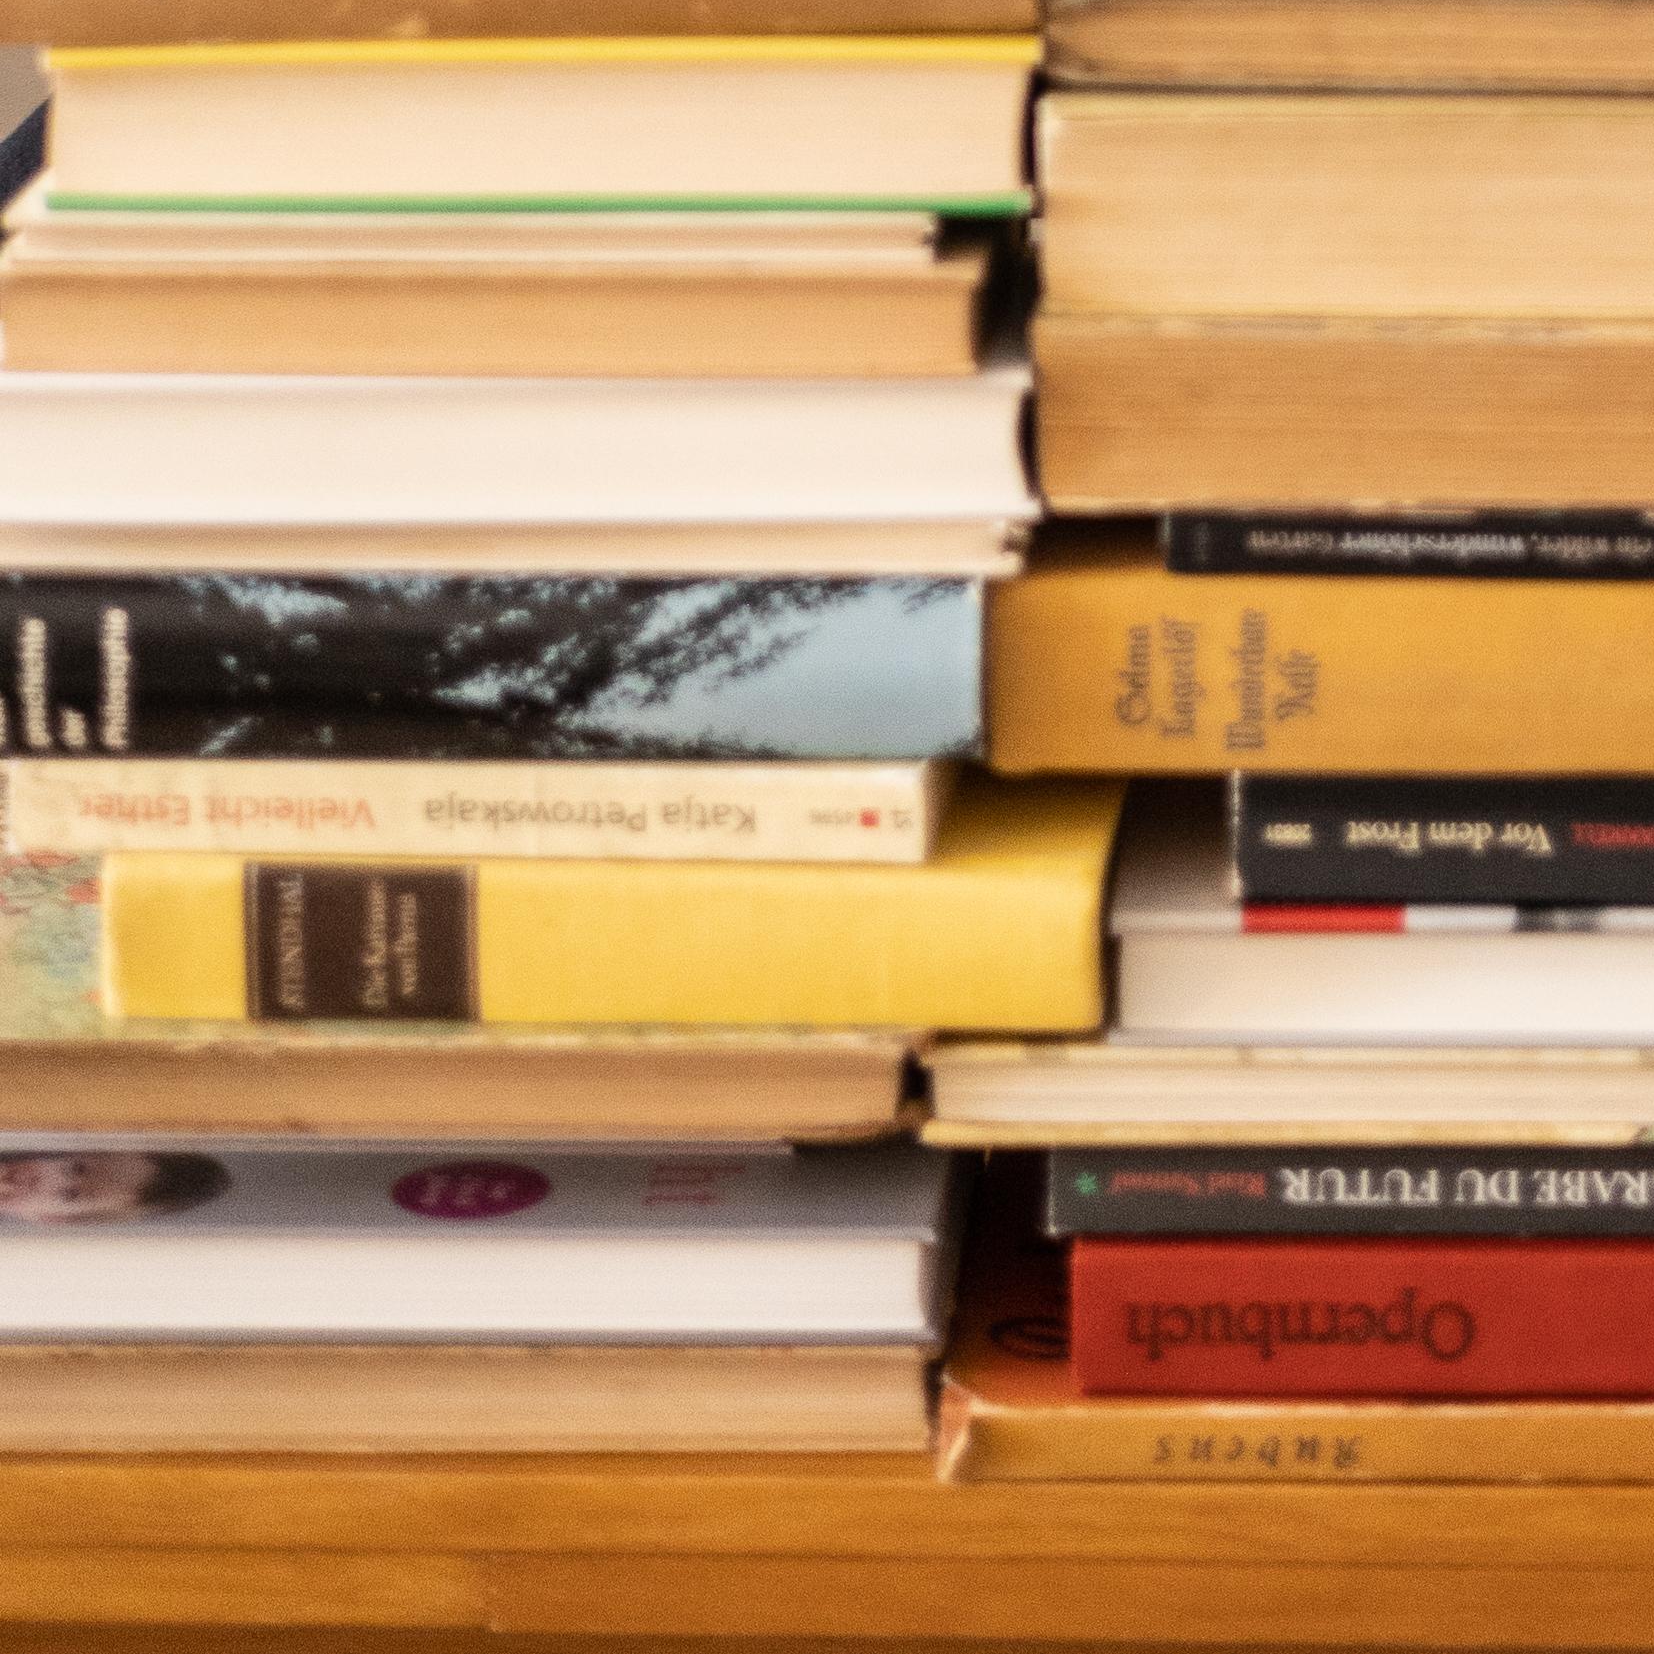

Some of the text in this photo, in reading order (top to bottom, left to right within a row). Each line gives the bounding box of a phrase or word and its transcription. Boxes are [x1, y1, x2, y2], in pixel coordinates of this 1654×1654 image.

[102, 607, 130, 750] Philosophie
[77, 792, 378, 832] Vielleicht Esther
[423, 797, 757, 838] Katja Petrowskaja
[1345, 818, 1421, 852] Frost
[1428, 818, 1494, 852] dem
[1503, 820, 1553, 856] Vor
[1277, 1166, 1443, 1206] FUTUR
[1454, 1166, 1522, 1206] DU
[1122, 1288, 1479, 1367] Opernbuch
[1149, 1431, 1367, 1471] Rubens
